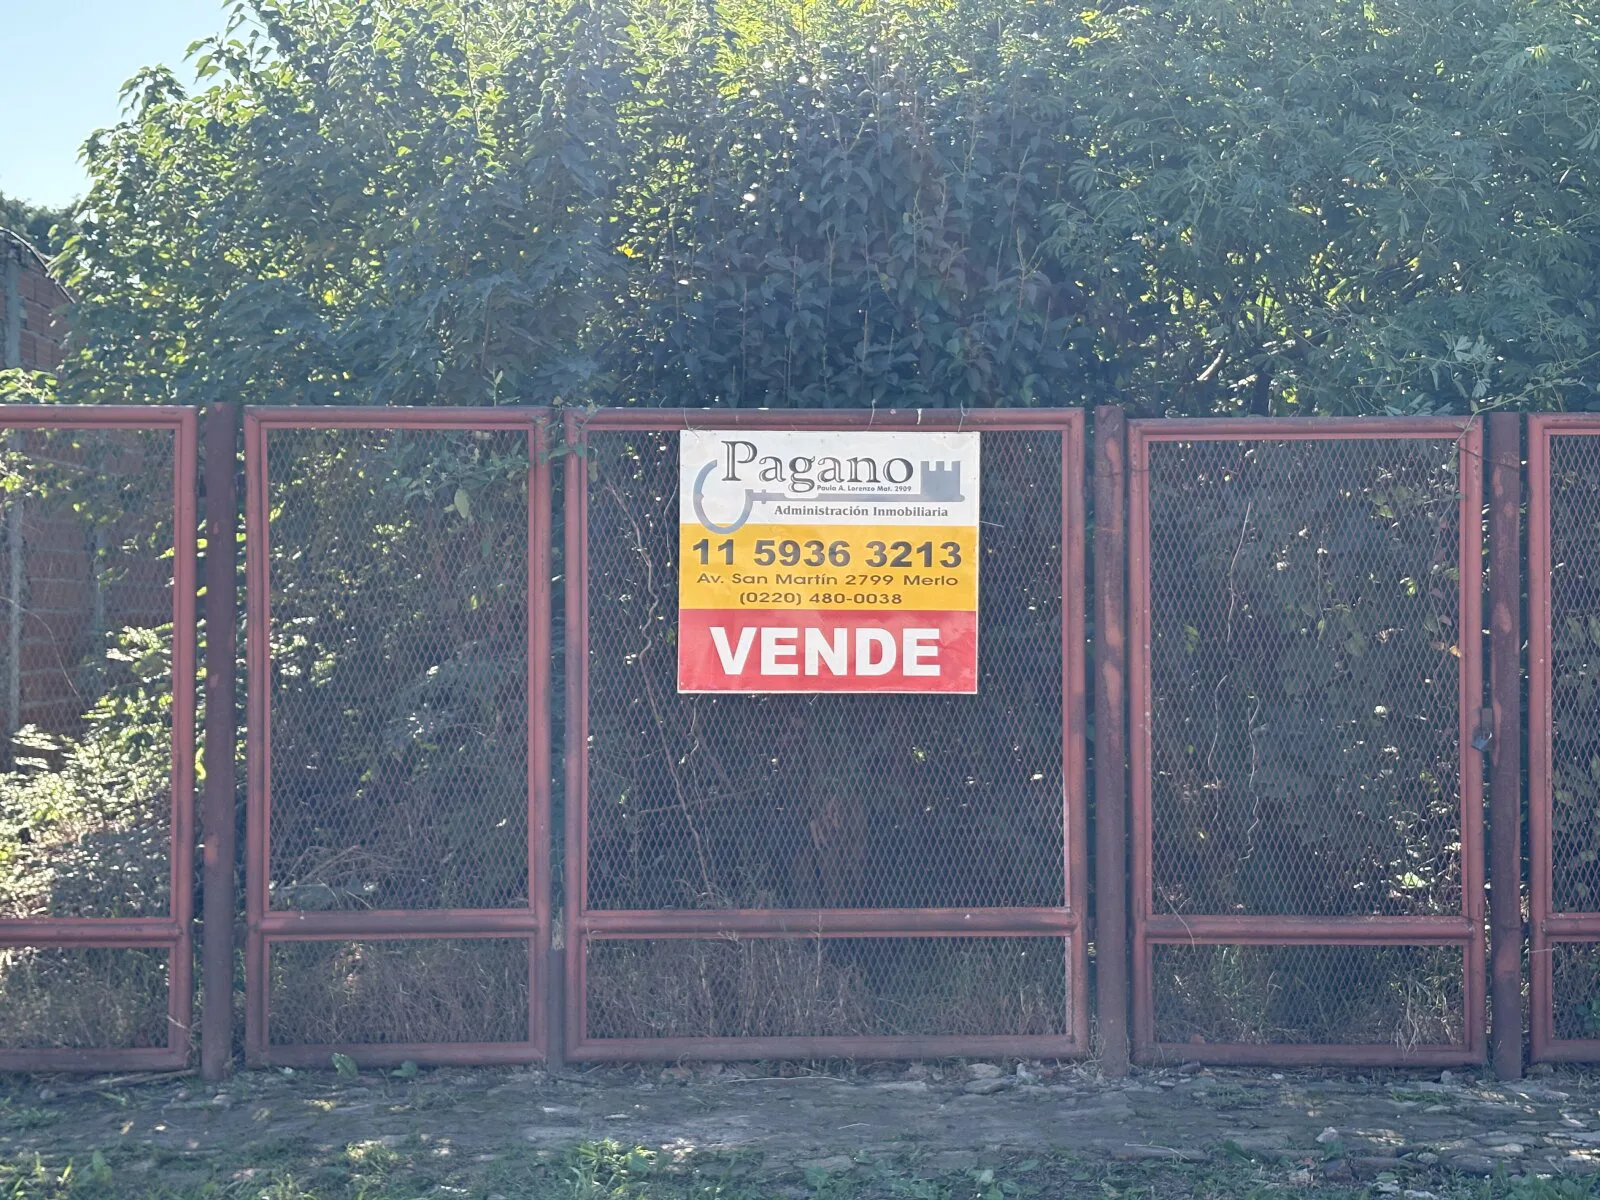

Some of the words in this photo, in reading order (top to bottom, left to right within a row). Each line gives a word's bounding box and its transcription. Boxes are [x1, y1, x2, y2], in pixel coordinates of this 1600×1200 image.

[721, 440, 914, 493] Pagano
[774, 505, 869, 517] Administración
[873, 506, 948, 517] Inmobiliaria
[692, 538, 734, 565] 11
[753, 539, 851, 567] 5936
[865, 540, 962, 568] 3213
[696, 573, 724, 584] Av.
[732, 573, 768, 585] San
[775, 573, 838, 585] Martín
[845, 574, 894, 586] 2799
[903, 575, 959, 586] Merlo
[739, 592, 802, 606] (0220)
[809, 593, 903, 605] 480-0038
[709, 626, 941, 677] VENDE
